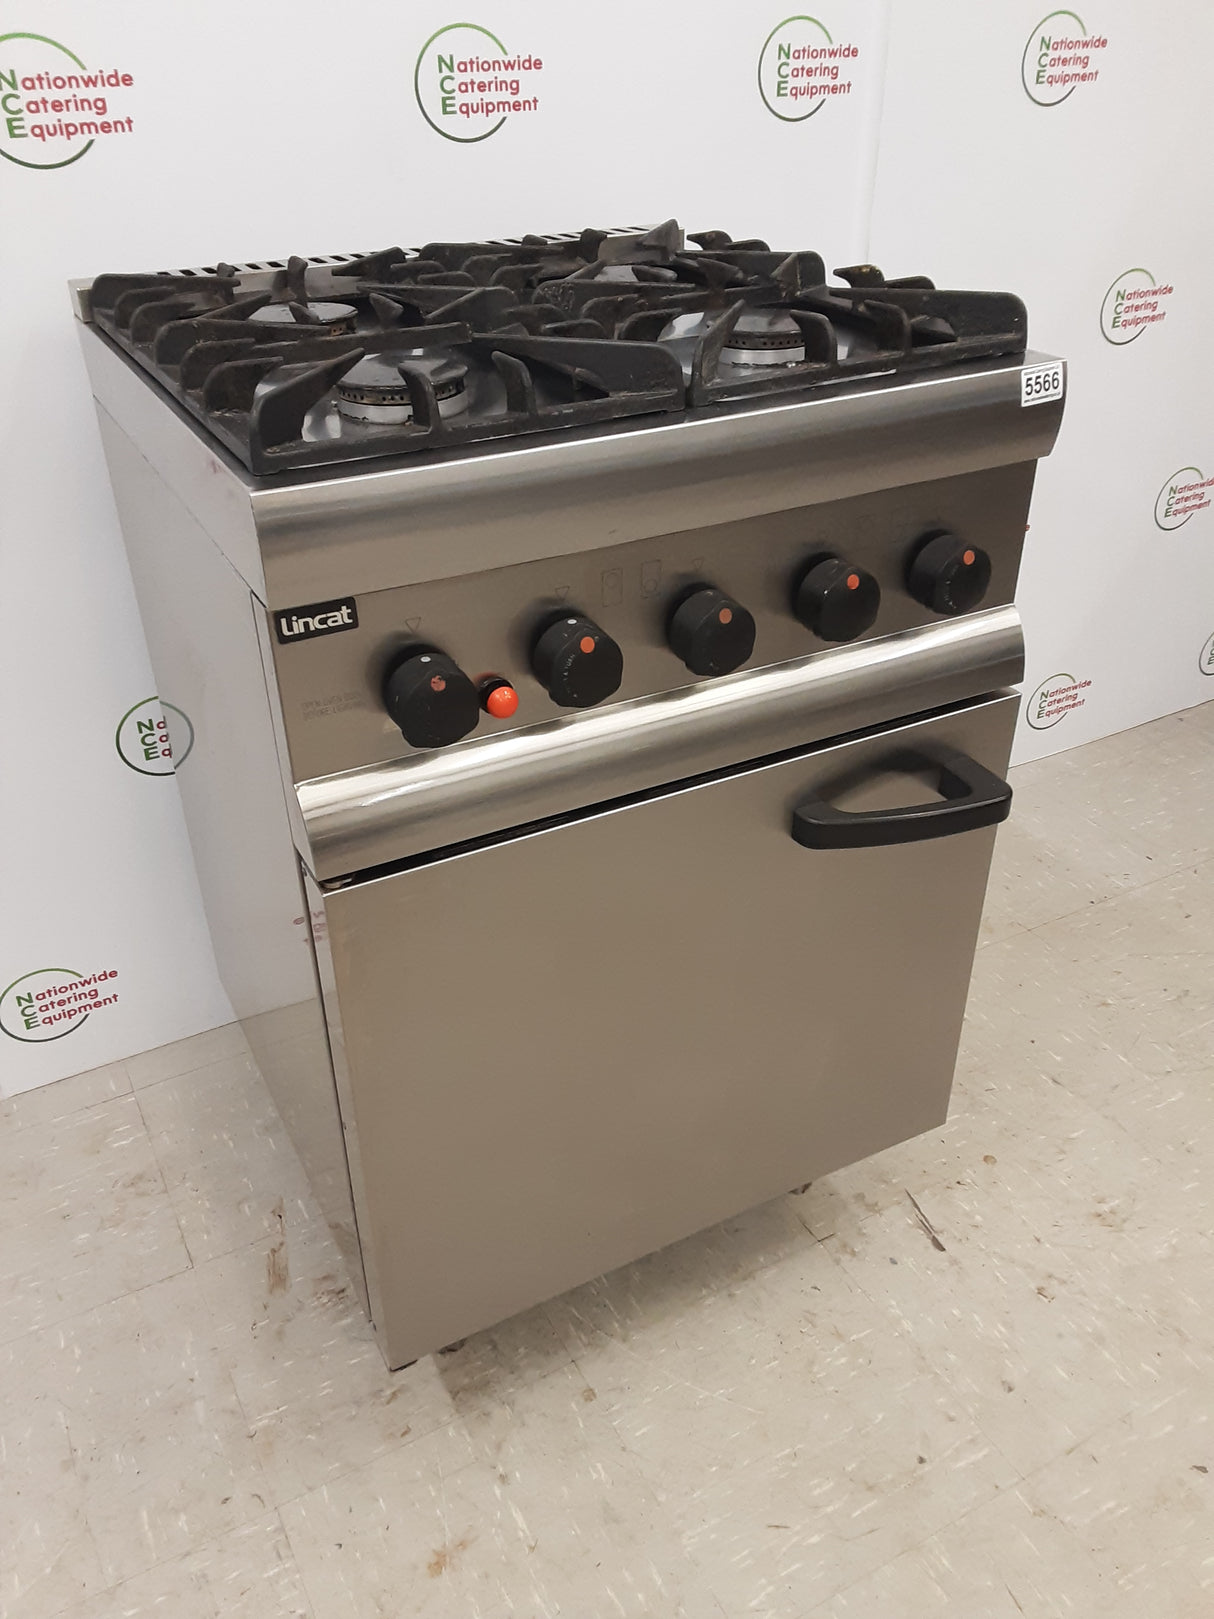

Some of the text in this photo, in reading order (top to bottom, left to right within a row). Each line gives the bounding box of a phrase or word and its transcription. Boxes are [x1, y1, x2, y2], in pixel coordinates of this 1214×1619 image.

[777, 42, 859, 60] Nationwide
[1040, 35, 1108, 51] Nationwide
[437, 54, 543, 73] Nationwide
[777, 61, 839, 80] Catering
[1038, 52, 1090, 69] Catering
[0, 69, 134, 91] Nationwide
[439, 75, 520, 96] Catering
[1035, 69, 1099, 87] Equipment
[776, 80, 852, 100] Equipment
[1, 93, 108, 116] Catering
[441, 96, 539, 118] Equipment
[6, 117, 134, 142] Equipment
[1115, 284, 1174, 302] Nationwide
[1113, 300, 1158, 315] Catering
[1111, 310, 1166, 329] Equipment
[1025, 371, 1060, 396] 5566
[1168, 477, 1214, 496] Nationwid
[1166, 491, 1205, 506] Catering
[280, 605, 353, 636] Lincat
[1040, 680, 1092, 700] Nationwide
[1036, 698, 1085, 719] Equipment
[1038, 693, 1078, 709] Catering
[16, 970, 118, 1007] Nationwide
[21, 988, 99, 1017] Catering
[24, 993, 119, 1030] Equipment
